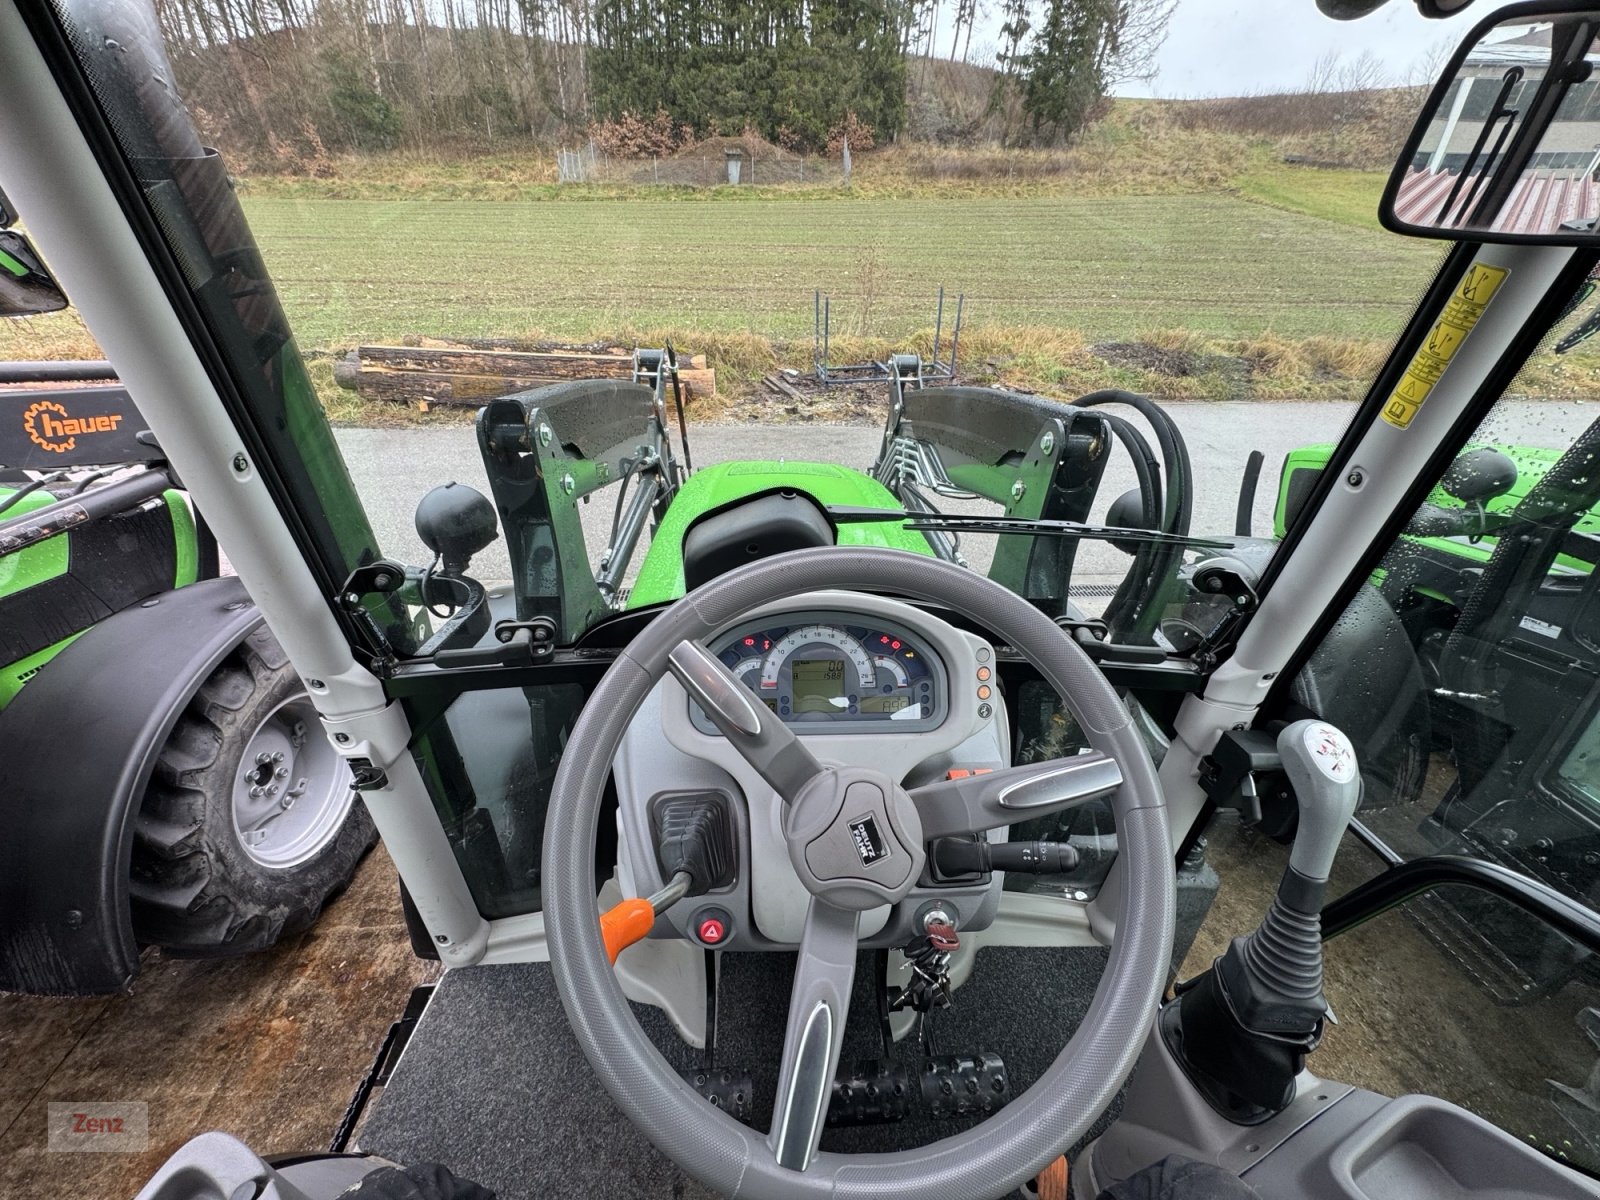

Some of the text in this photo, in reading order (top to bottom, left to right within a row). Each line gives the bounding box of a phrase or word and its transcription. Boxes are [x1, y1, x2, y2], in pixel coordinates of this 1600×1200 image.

[42, 413, 122, 438] hauer
[853, 829, 868, 857] FAHR
[858, 823, 876, 858] DEUTZ
